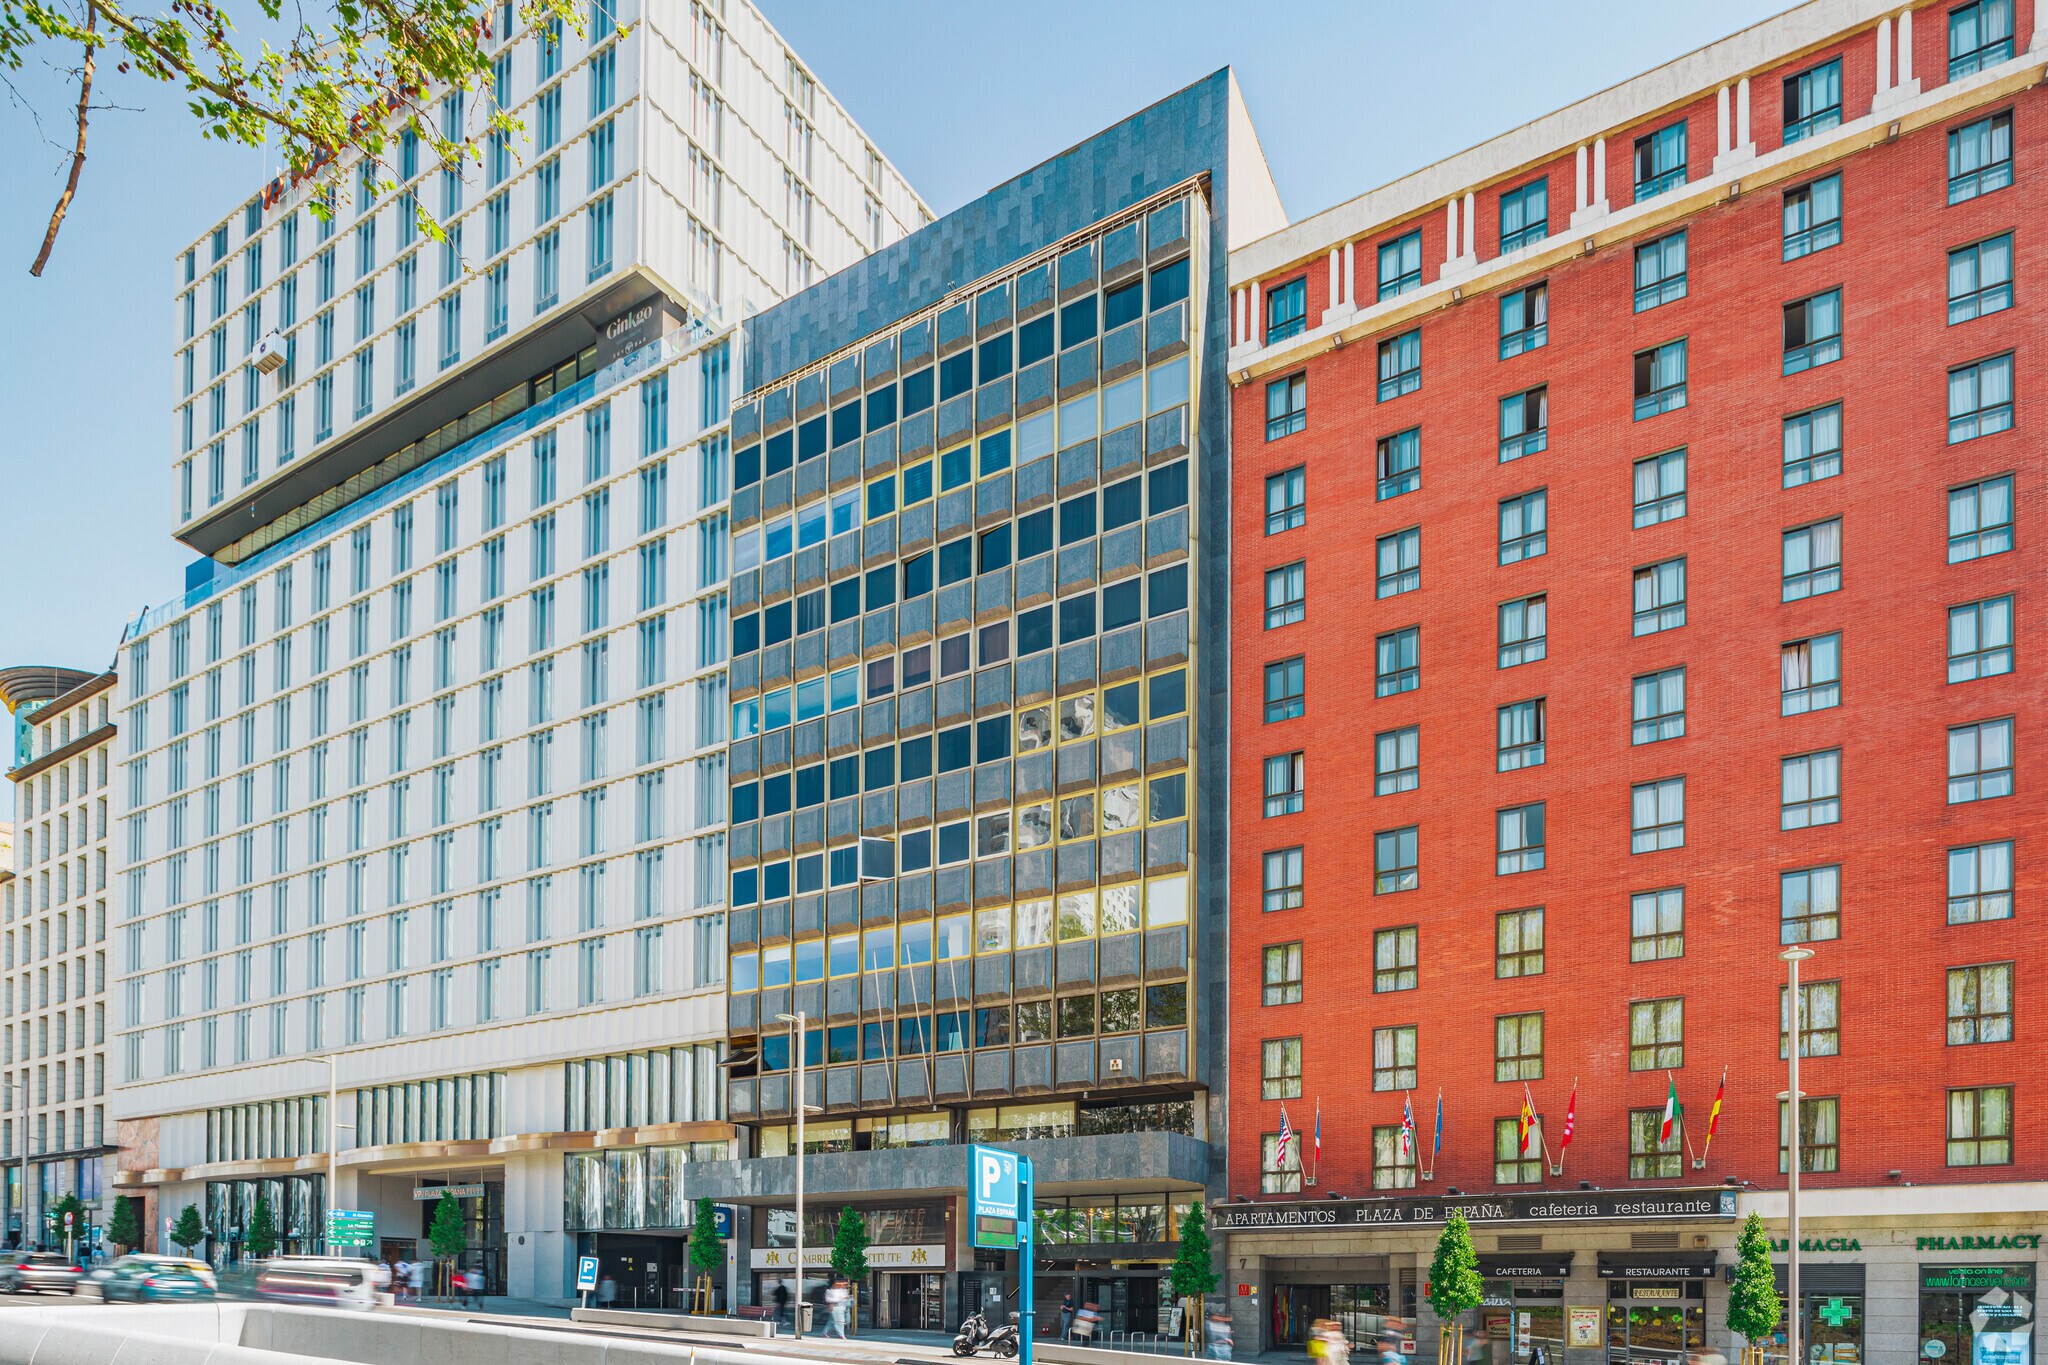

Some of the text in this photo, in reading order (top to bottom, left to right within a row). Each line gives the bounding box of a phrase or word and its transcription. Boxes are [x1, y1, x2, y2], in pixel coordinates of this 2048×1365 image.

[606, 306, 653, 339] Ginkgo
[982, 1155, 1001, 1198] P
[978, 1205, 1015, 1216] PLAZA ESPAÑA
[1225, 1211, 1336, 1225] APARTAMENTOS
[1356, 1209, 1403, 1222] PLAZA
[1413, 1207, 1434, 1220] DE
[1444, 1203, 1504, 1219] ESPAÑA
[1529, 1202, 1598, 1217] cafeteria
[1614, 1200, 1711, 1214] restaurante
[1916, 1234, 2042, 1251] PHARMACY
[583, 1261, 594, 1273] P
[1240, 1258, 1247, 1269] 7
[1496, 1268, 1542, 1276] CAFETERIA
[1625, 1267, 1690, 1276] RESTAURANTE
[1634, 1289, 1679, 1297] RESTAURANTE
